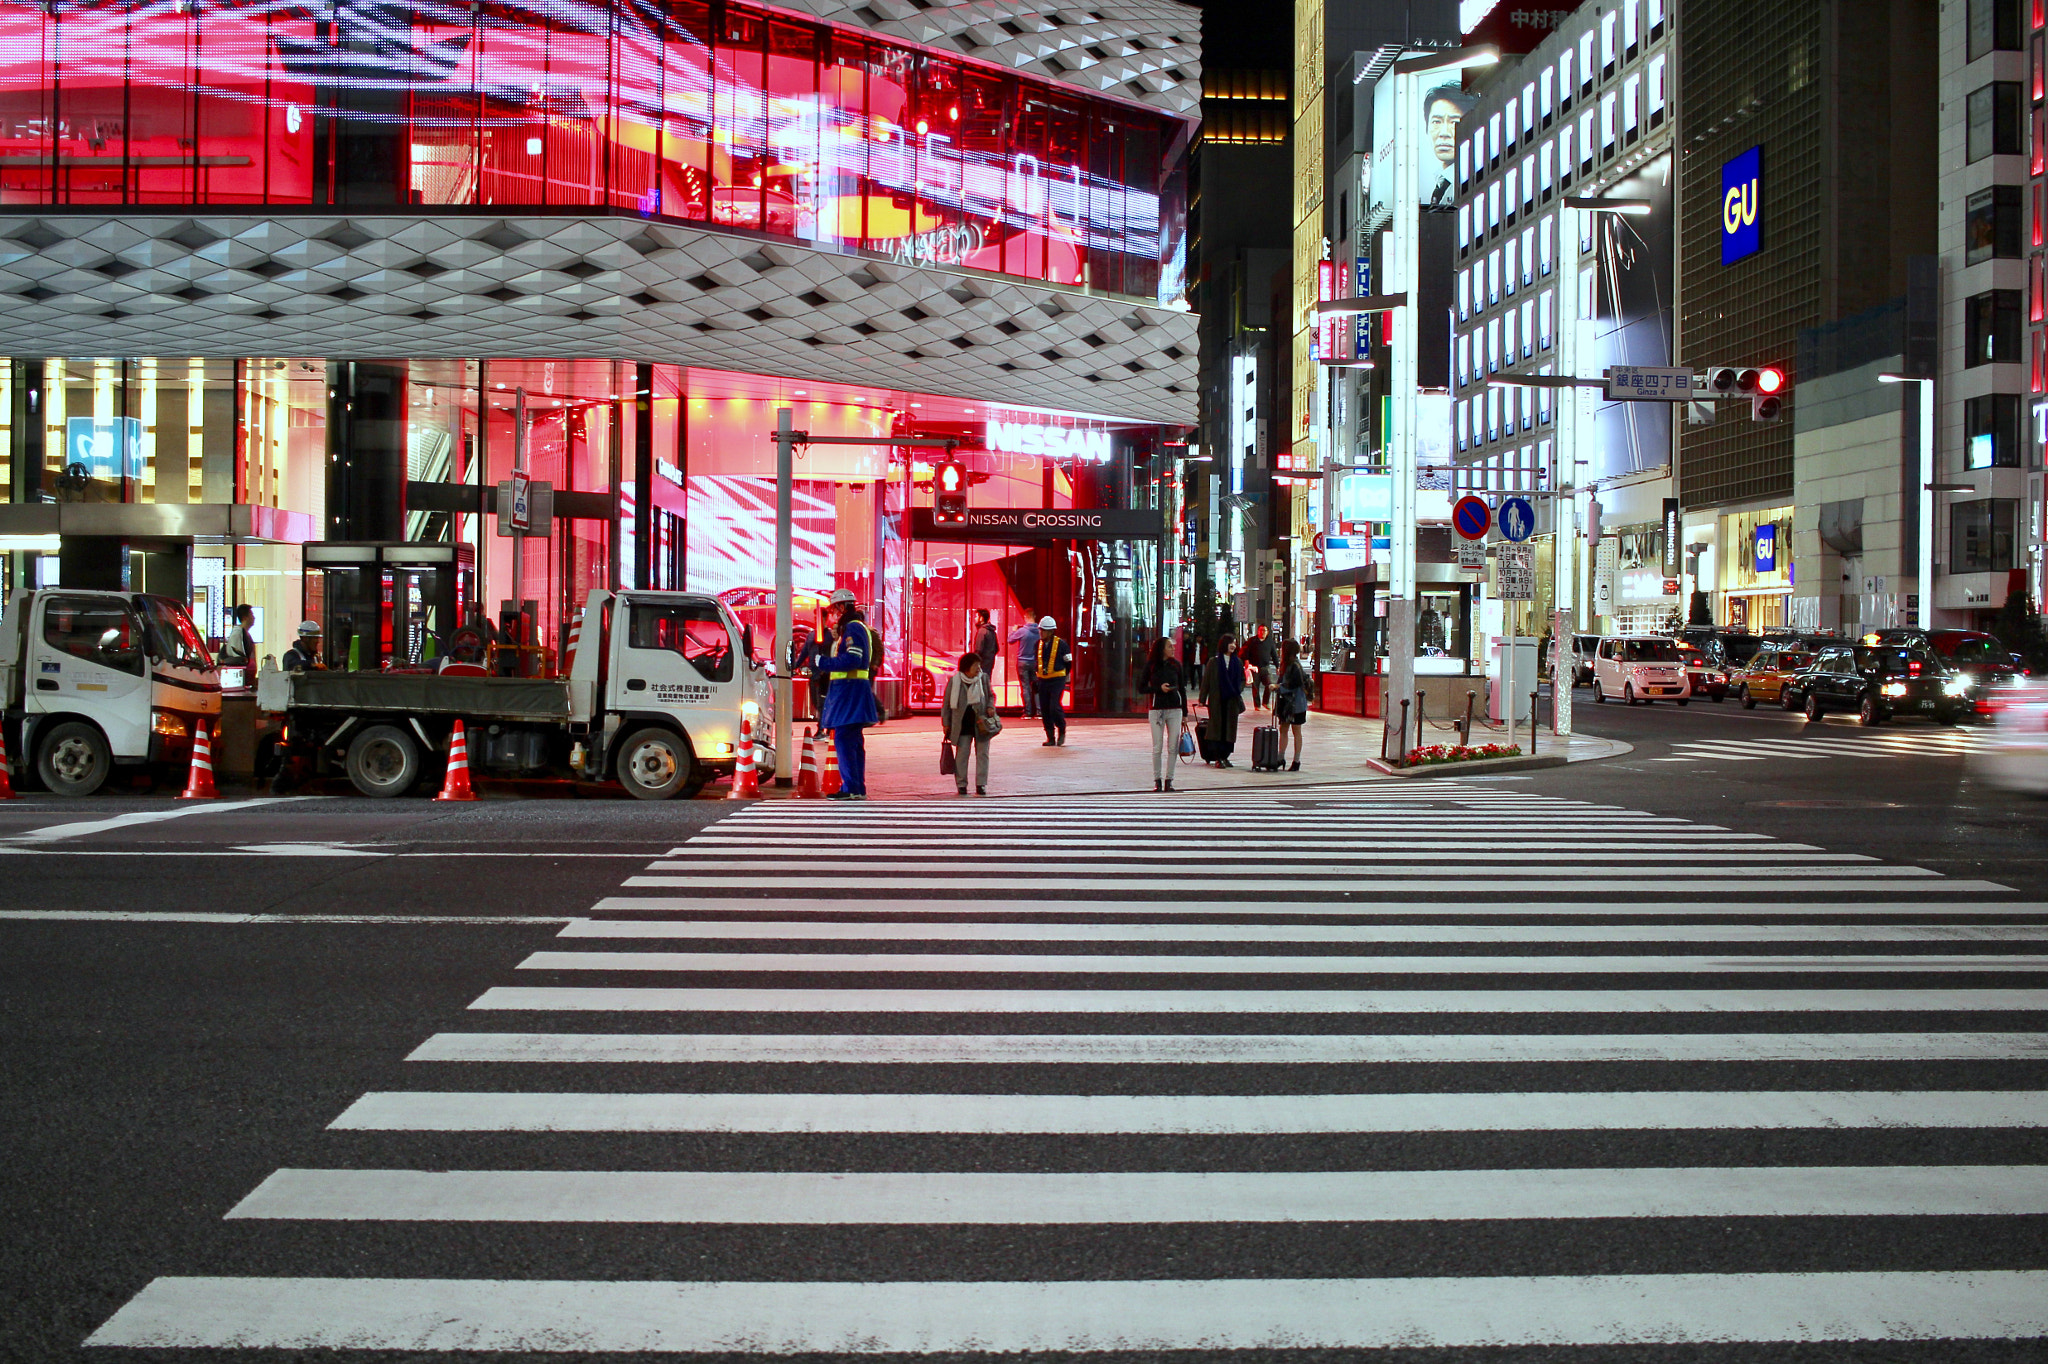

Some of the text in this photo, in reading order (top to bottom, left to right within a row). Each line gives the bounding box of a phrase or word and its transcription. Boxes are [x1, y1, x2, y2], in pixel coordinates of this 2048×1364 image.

[1723, 178, 1757, 235] GU
[1616, 374, 1687, 388] 銀座四丁目
[1636, 388, 1657, 396] Ginza
[986, 420, 1112, 462] NISSAN
[970, 511, 1102, 527] NISSAN CROSSING
[1667, 510, 1676, 566] WASHINGTON
[1756, 537, 1774, 560] GU
